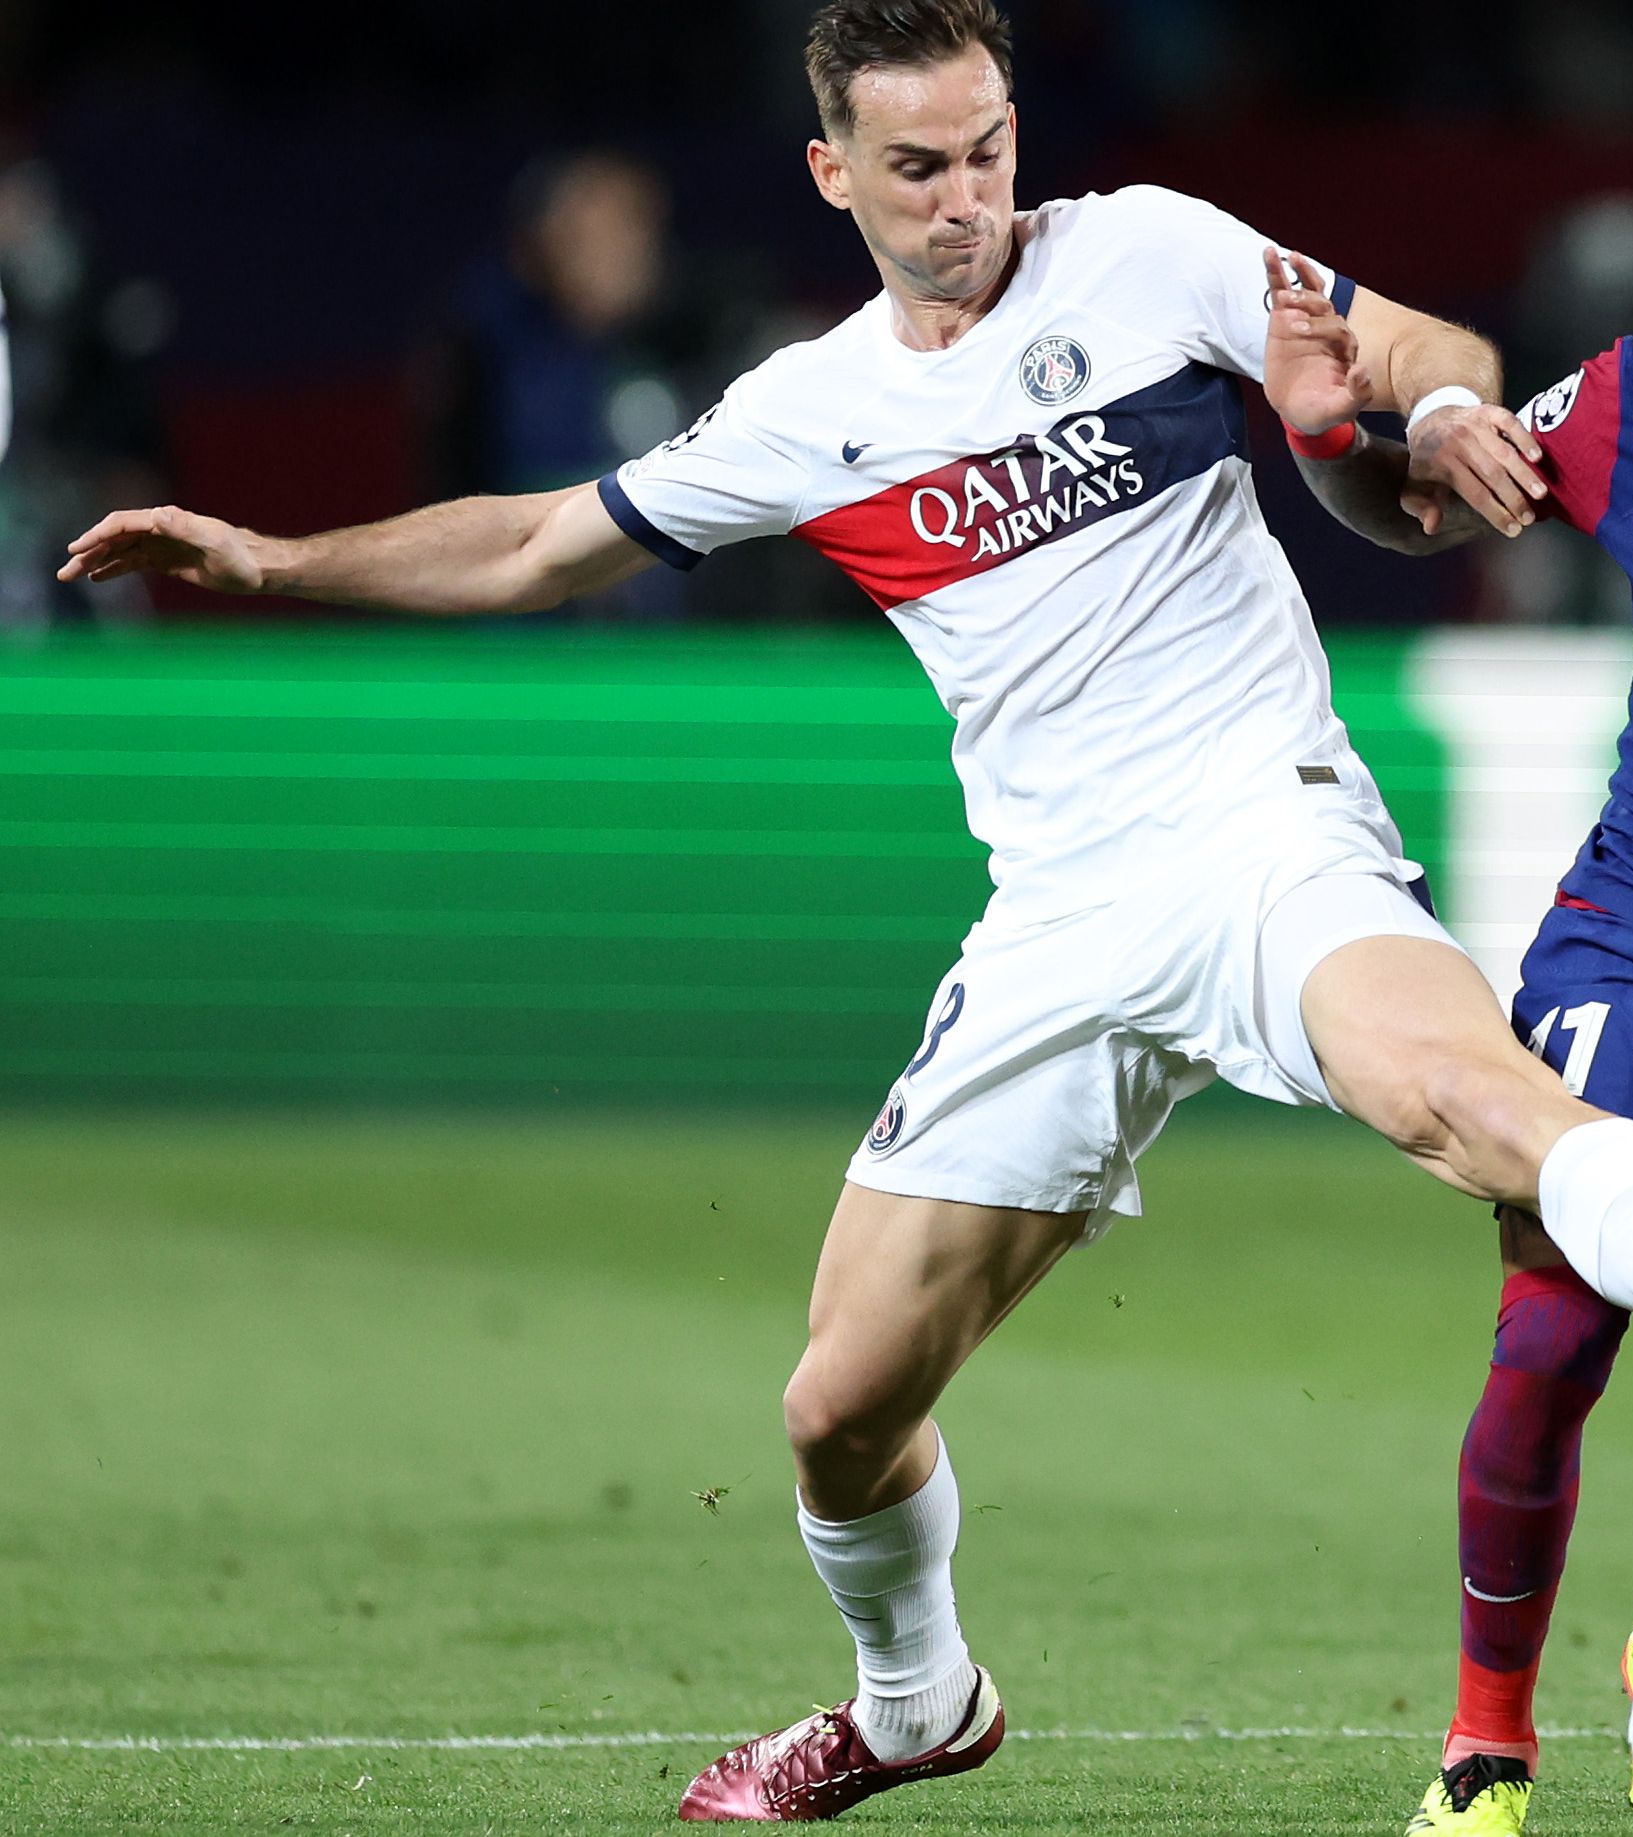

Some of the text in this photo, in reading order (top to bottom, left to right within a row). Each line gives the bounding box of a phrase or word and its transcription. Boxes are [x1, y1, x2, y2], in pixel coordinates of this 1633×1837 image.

[1026, 340, 1067, 367] PARIS
[910, 415, 1133, 548] QATAR
[970, 458, 1144, 562] AIRWAYS
